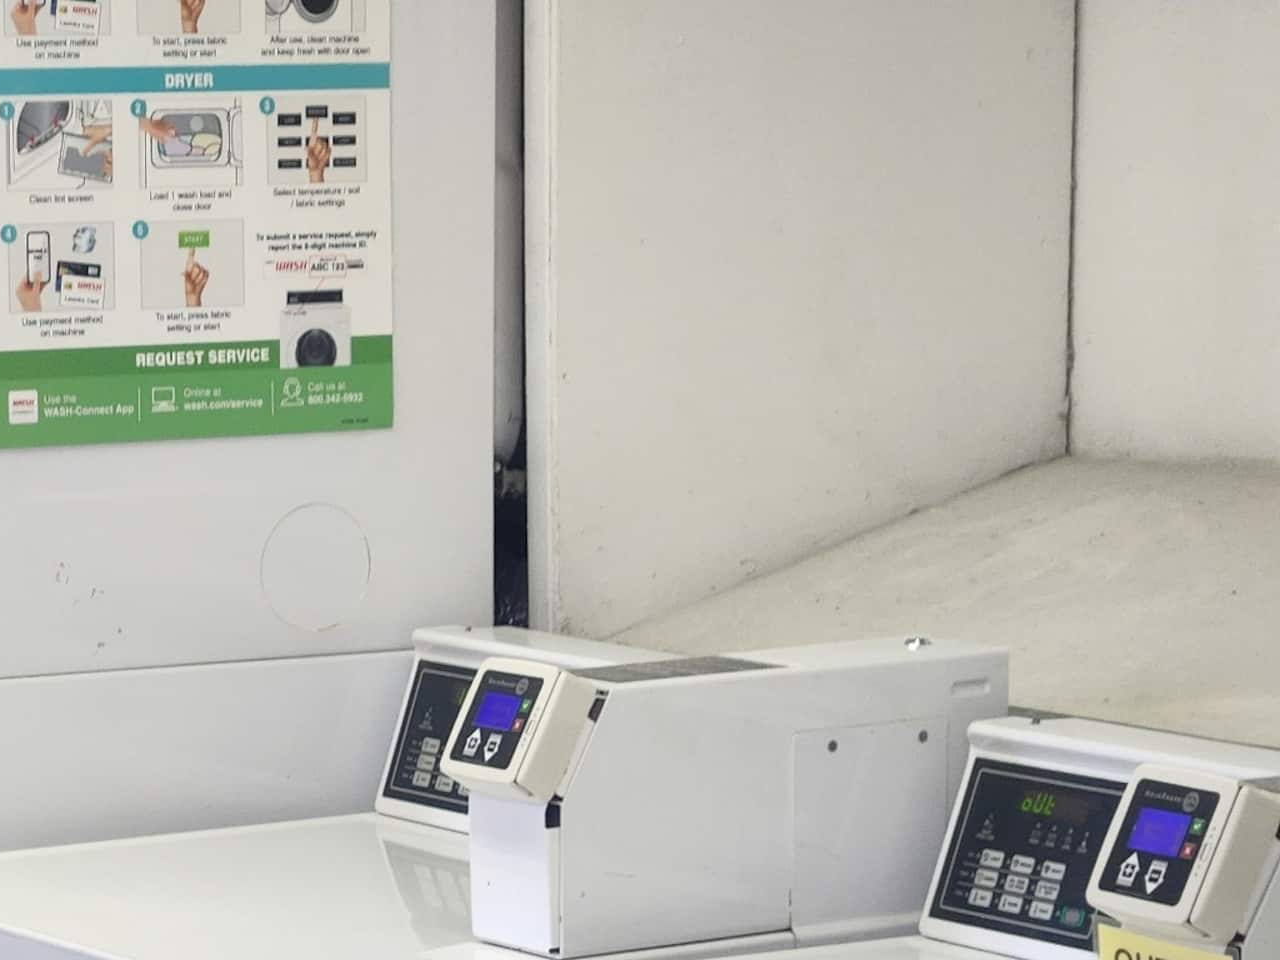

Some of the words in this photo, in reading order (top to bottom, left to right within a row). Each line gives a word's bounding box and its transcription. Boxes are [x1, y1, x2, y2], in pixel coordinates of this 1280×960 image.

[16, 39, 32, 48] Use
[34, 39, 67, 49] payment
[69, 38, 99, 47] method
[270, 36, 287, 44] After
[307, 36, 326, 44] clean
[329, 35, 360, 43] machine
[47, 51, 80, 59] machine
[163, 50, 188, 59] setting
[199, 49, 217, 57] start
[261, 48, 275, 56] and
[277, 48, 295, 57] keep
[297, 47, 316, 55] fresh
[317, 46, 331, 55] with
[333, 46, 350, 55] door
[352, 47, 370, 57] open
[164, 72, 214, 89] DRYER
[150, 191, 169, 201] Load
[178, 191, 199, 200] wash
[218, 190, 232, 198] and
[273, 188, 296, 197] Select
[298, 187, 343, 197] temperature
[29, 194, 53, 205] Clean
[68, 194, 94, 203] screen
[295, 199, 315, 208] fabric
[317, 199, 346, 208] settings
[195, 202, 211, 211] door
[266, 232, 290, 241] submit
[298, 232, 323, 240] service
[355, 230, 377, 240] simply
[268, 243, 289, 252] report
[310, 262, 328, 271] ABC
[22, 317, 37, 326] Use
[39, 316, 72, 327] payment
[74, 315, 104, 325] method
[156, 312, 165, 321] To
[187, 312, 208, 322] press
[210, 311, 231, 320] fabric
[40, 329, 51, 337] on
[52, 328, 85, 336] machine
[167, 324, 192, 333] setting
[203, 322, 221, 331] start
[136, 350, 204, 368] REQUEST
[208, 347, 270, 365] SERVICE
[307, 381, 325, 392] Call
[183, 387, 210, 398] Online
[43, 394, 61, 405] Use
[63, 393, 77, 403] the
[43, 404, 113, 417] WASH-Connect
[115, 403, 135, 416] App
